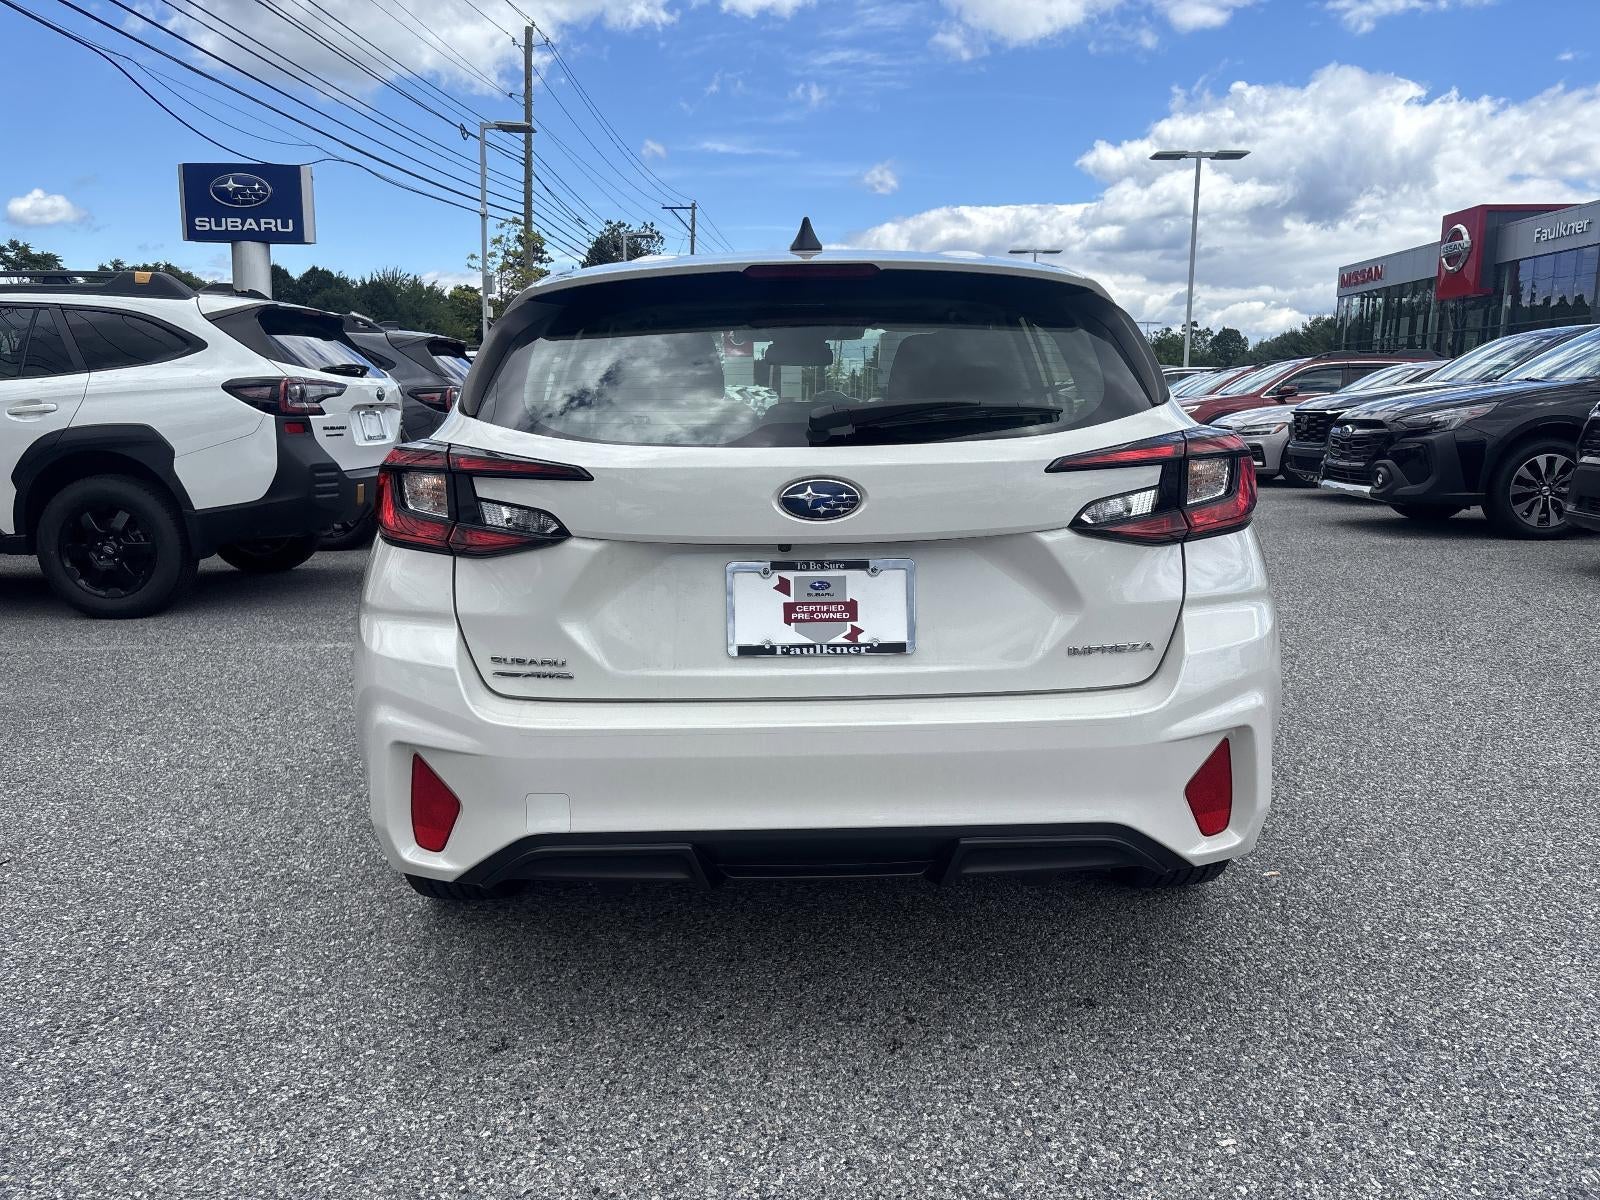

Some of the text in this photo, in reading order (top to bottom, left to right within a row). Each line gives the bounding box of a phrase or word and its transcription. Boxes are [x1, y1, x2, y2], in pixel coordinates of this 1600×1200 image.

[194, 217, 293, 232] SUBARU
[1533, 218, 1590, 243] Faulkner
[1340, 264, 1384, 288] NISSAN
[797, 561, 845, 570] To Be Sure
[796, 604, 845, 612] CERTIFIED
[776, 645, 871, 655] Faulkner
[1067, 641, 1154, 656] IMPREZA
[490, 656, 566, 667] SUBARU
